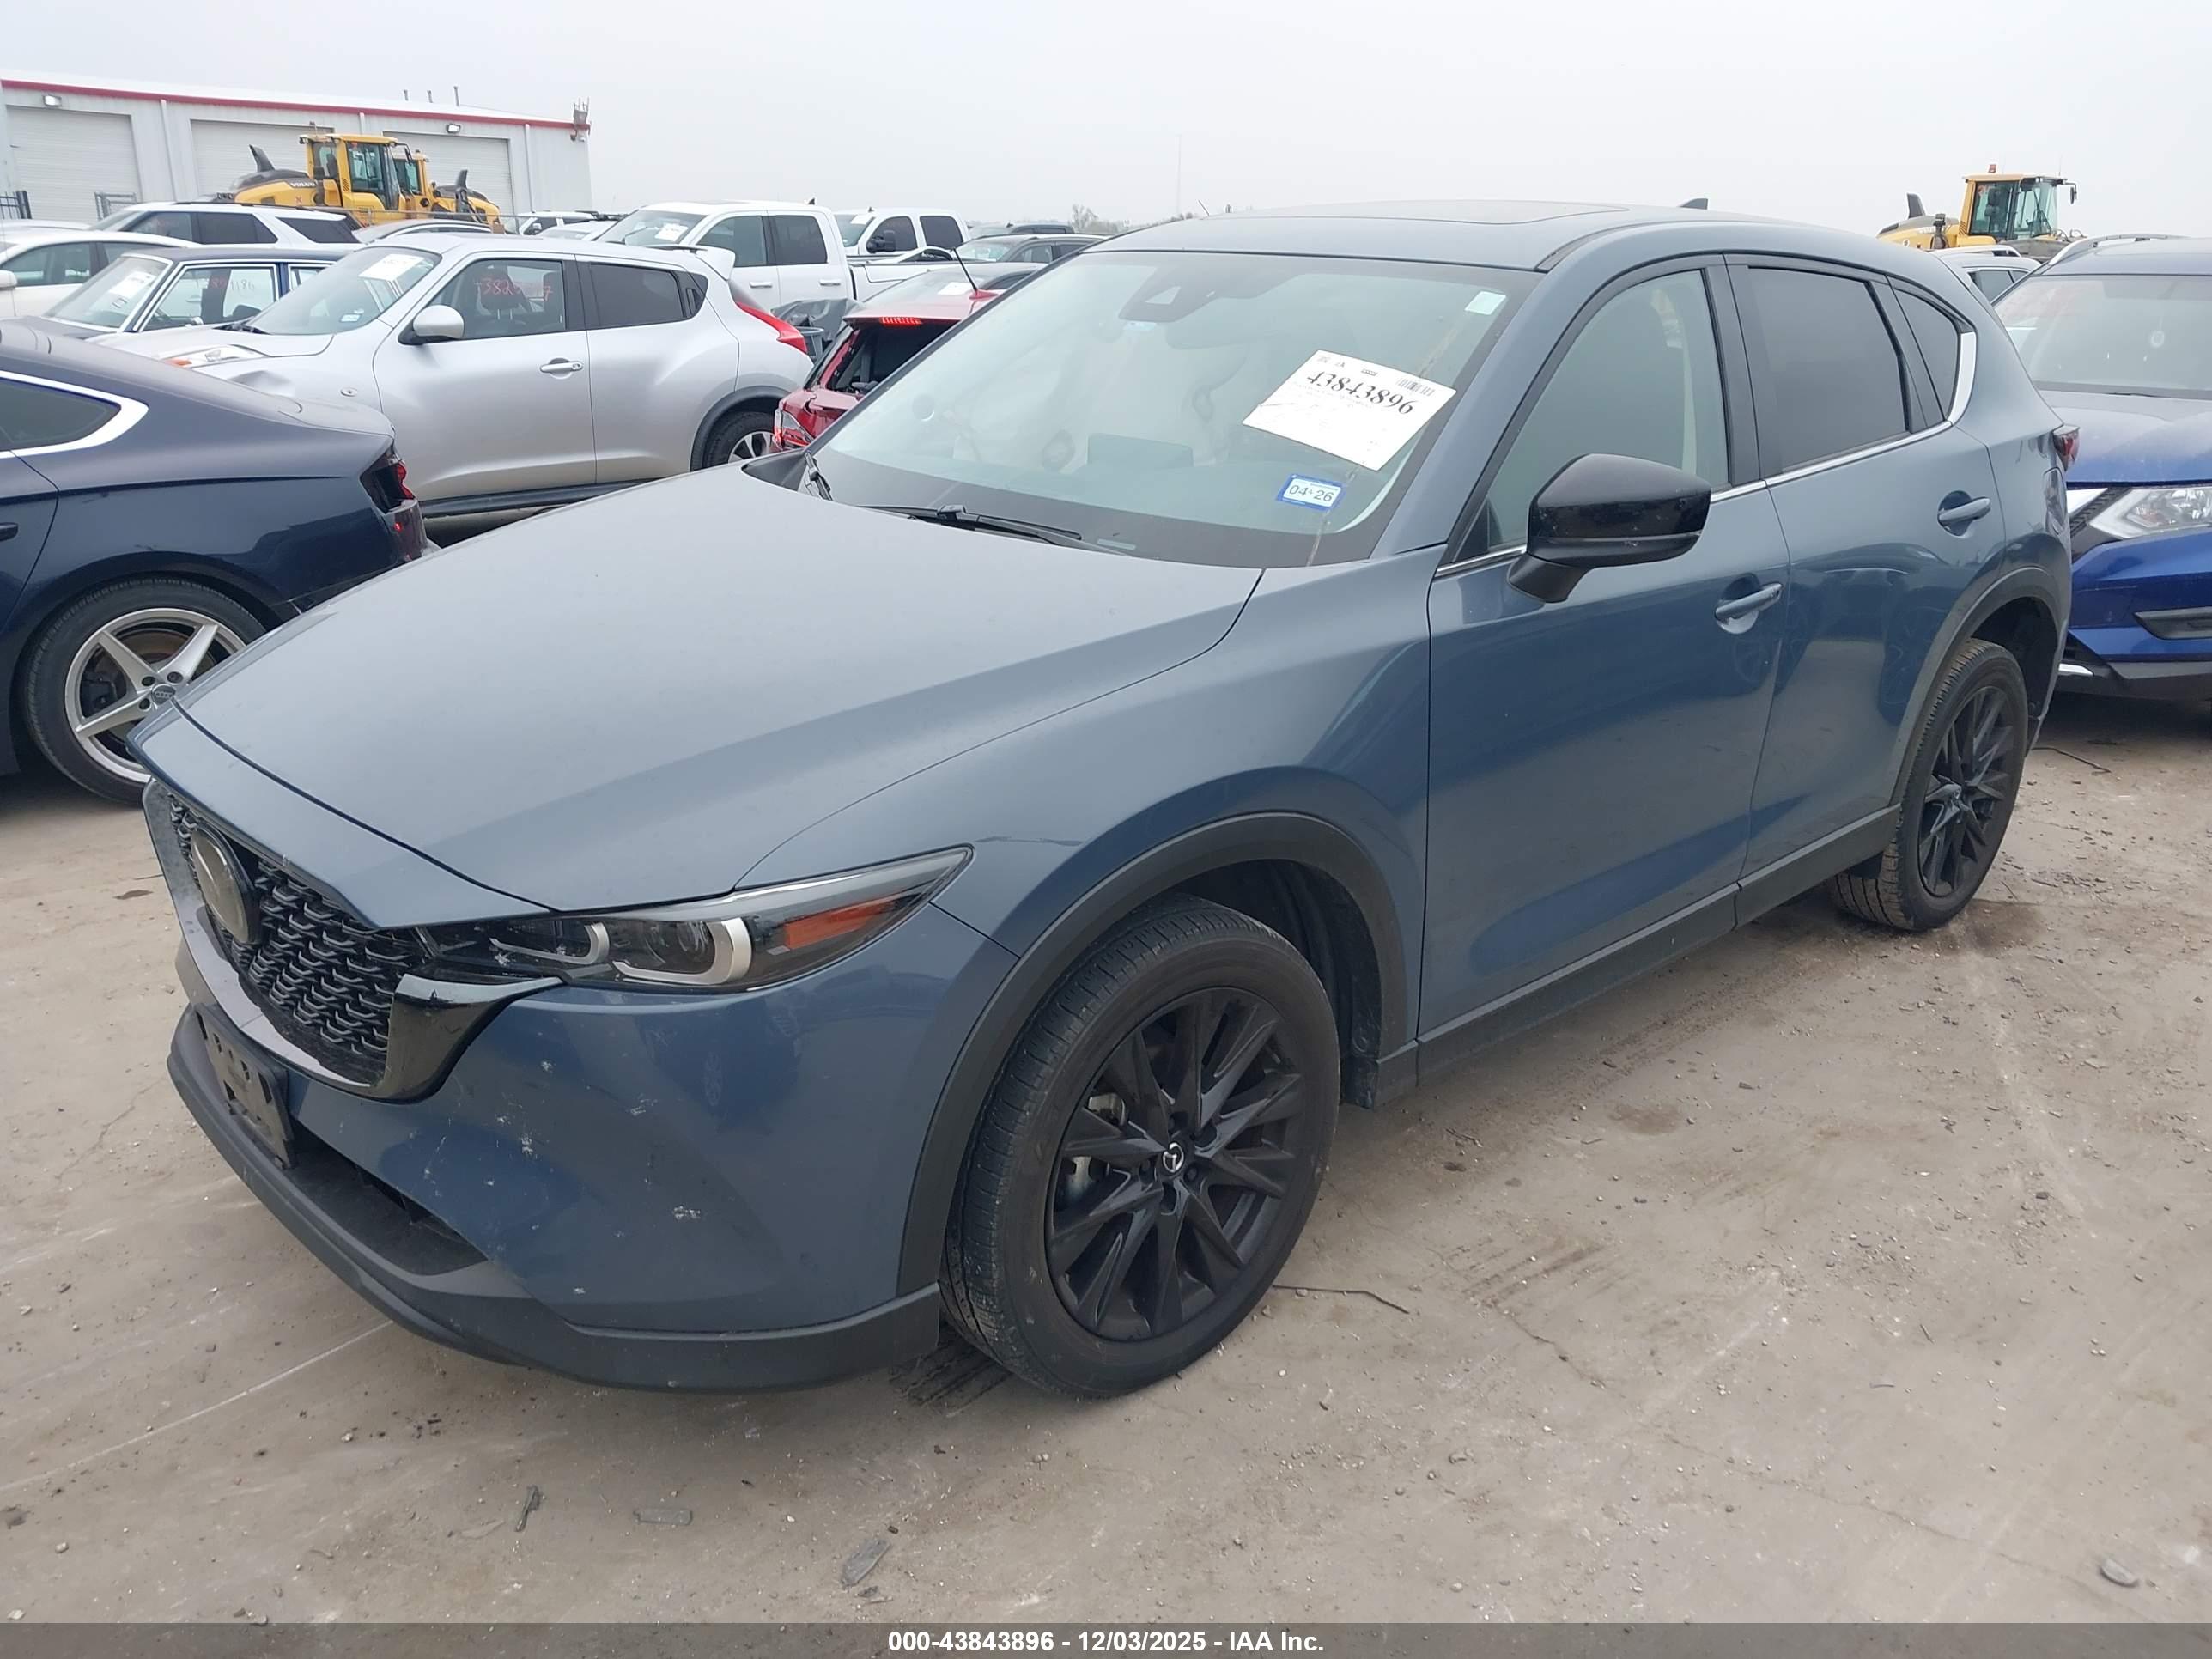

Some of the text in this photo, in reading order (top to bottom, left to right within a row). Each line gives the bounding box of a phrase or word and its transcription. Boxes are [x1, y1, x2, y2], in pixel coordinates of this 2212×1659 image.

[1307, 371, 1419, 414] 43843896
[1289, 484, 1309, 496] 04
[1313, 489, 1334, 502] 26
